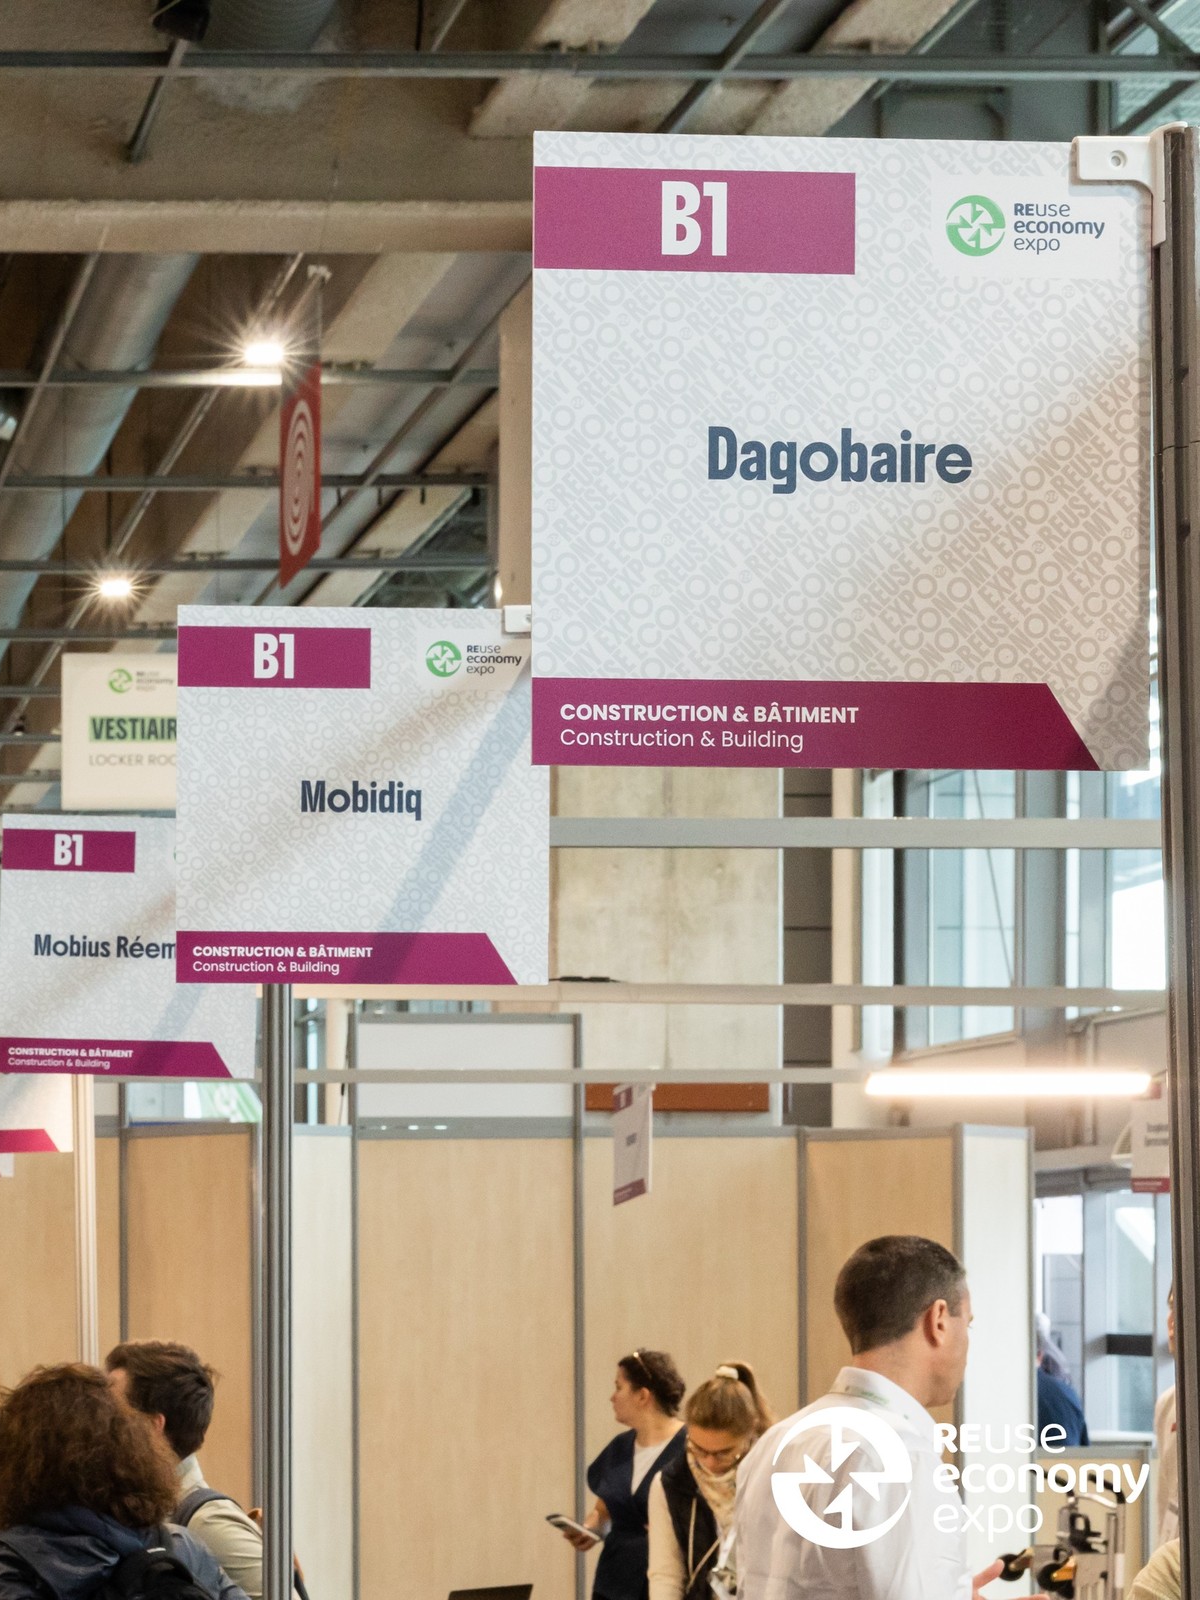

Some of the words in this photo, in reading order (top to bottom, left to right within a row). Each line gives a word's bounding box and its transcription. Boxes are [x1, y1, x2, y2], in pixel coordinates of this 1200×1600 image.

[661, 181, 728, 257] B1
[1014, 203, 1071, 217] REuse
[1014, 220, 1105, 239] economy
[1014, 237, 1061, 255] expo
[708, 426, 972, 494] Dagobaire
[253, 633, 296, 679] B1
[466, 655, 522, 666] economy
[466, 665, 495, 676] expo
[560, 704, 728, 722] CONSTRUCTION
[732, 705, 749, 722] &
[754, 701, 859, 724] BÂTIMENT
[92, 718, 177, 740] VESTIAIR
[560, 728, 694, 747] Construction
[700, 730, 716, 747] &
[722, 730, 804, 753] Building
[89, 754, 144, 767] LOCKER
[300, 780, 422, 821] Mobidiq
[54, 833, 83, 866] B1
[34, 934, 111, 959] Mobius
[193, 946, 294, 958] CONSTRUCTION
[296, 947, 307, 958] &
[309, 944, 373, 958] BÂTIMENT
[193, 961, 274, 972] Construction
[277, 962, 286, 972] &
[290, 961, 340, 976] Building
[8, 1047, 79, 1057] CONSTRUCTION
[80, 1048, 87, 1057] &
[88, 1047, 133, 1058] BÂTIMENT
[8, 1057, 65, 1067] Construction
[66, 1058, 73, 1067] &
[75, 1058, 111, 1070] Building
